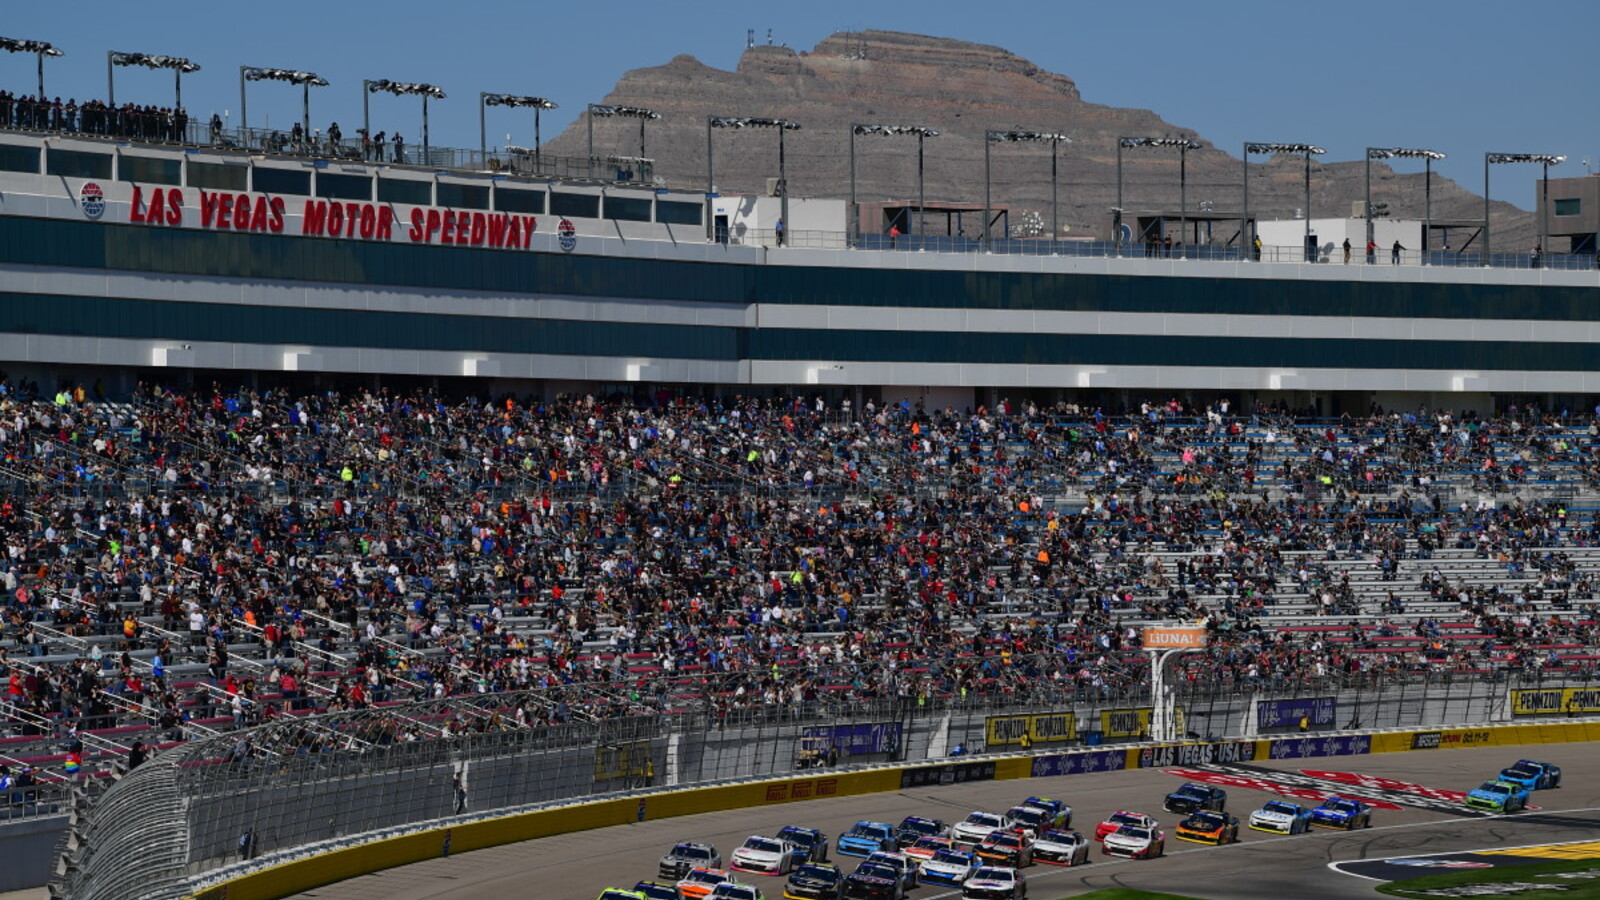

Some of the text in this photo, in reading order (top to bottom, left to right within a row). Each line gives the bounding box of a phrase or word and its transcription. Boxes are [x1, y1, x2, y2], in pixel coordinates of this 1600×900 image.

[130, 185, 183, 225] LAS
[200, 191, 285, 232] VEGAS
[303, 200, 392, 239] MOTOR
[409, 207, 536, 249] SPEEDWAY
[1521, 692, 1562, 710] PENNZOIL
[1036, 716, 1068, 737] PENNZOIL
[1153, 743, 1239, 766] LAS VEGAS USA
